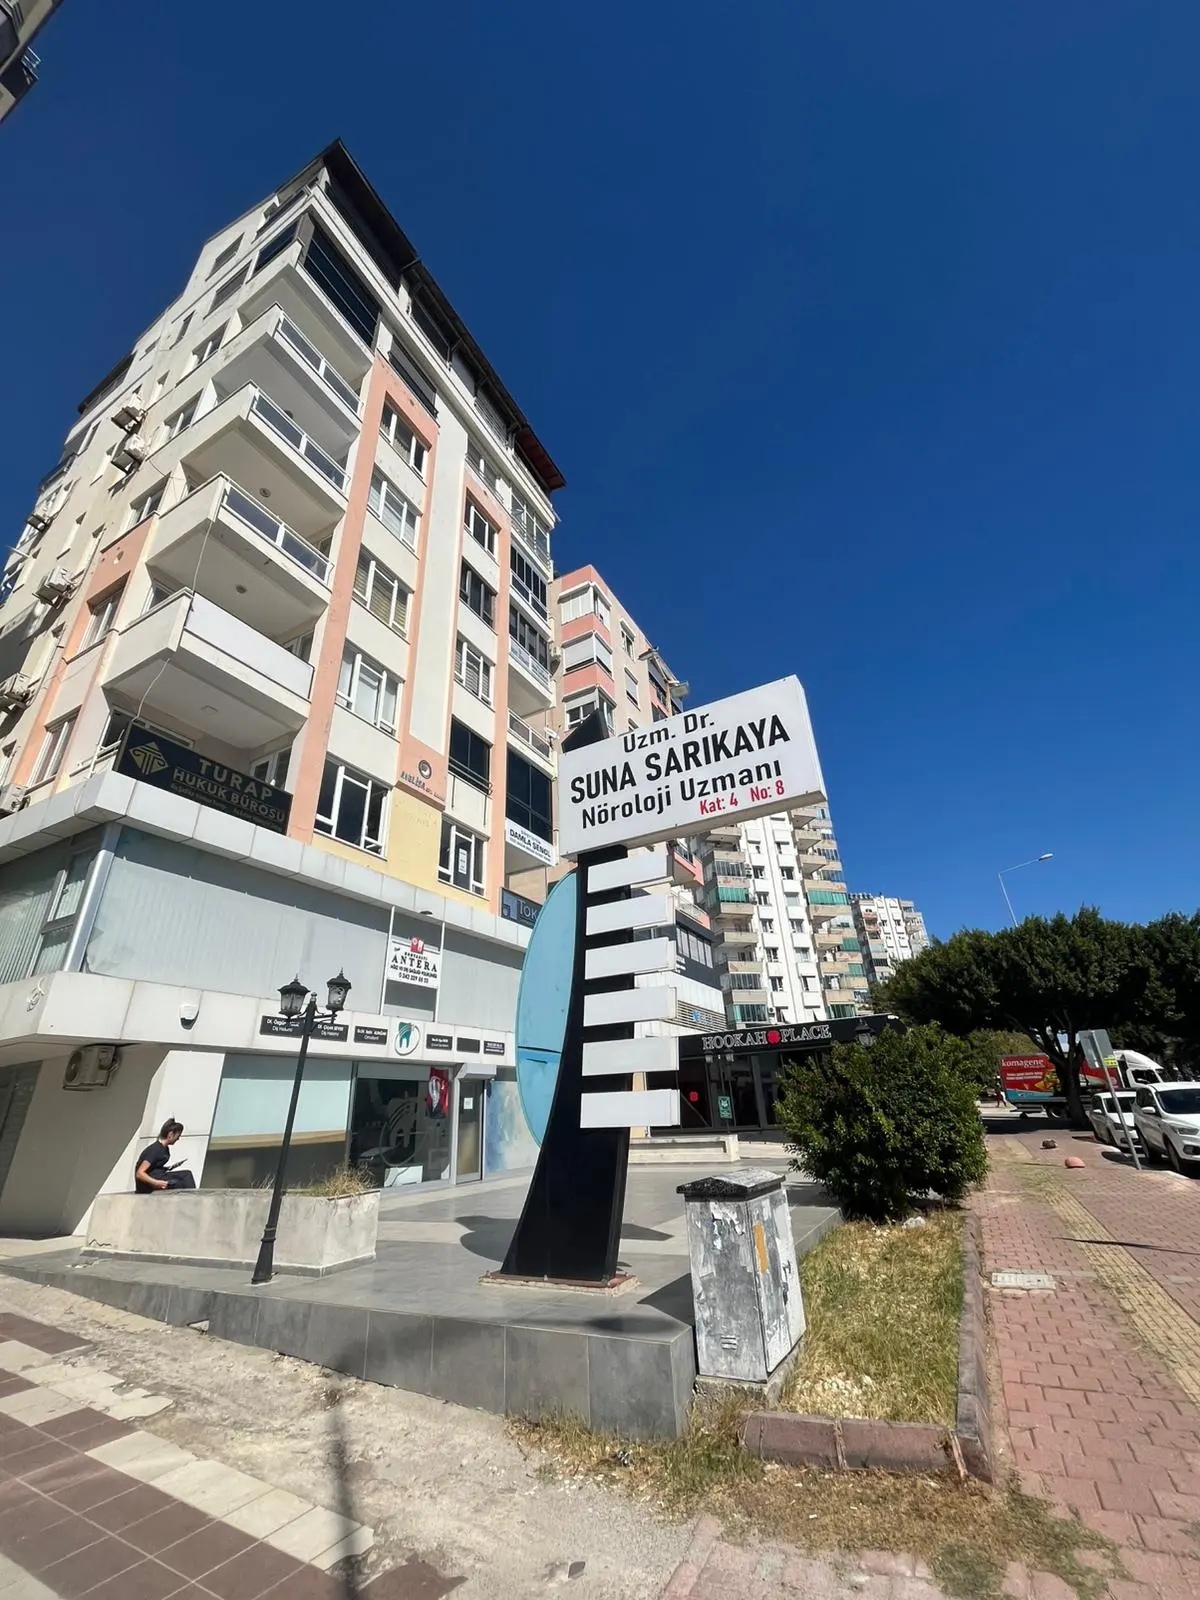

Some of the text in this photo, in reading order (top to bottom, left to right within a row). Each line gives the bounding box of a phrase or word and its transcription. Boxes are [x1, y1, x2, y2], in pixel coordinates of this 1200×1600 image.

[623, 712, 716, 753] Uzm. Dr.
[570, 714, 791, 804] SUNA SARIKAYA
[172, 768, 228, 799] HUKUK
[230, 792, 286, 822] BÜROSU
[199, 758, 273, 801] TURAP
[582, 760, 782, 829] Nöroloji Uzmanı
[699, 779, 785, 816] Kat: 4 No: 8
[509, 828, 532, 847] DAMLA
[391, 954, 437, 972] ANTERA
[701, 1024, 832, 1051] HOOKAH PLACE
[1001, 1058, 1044, 1068] komagene
